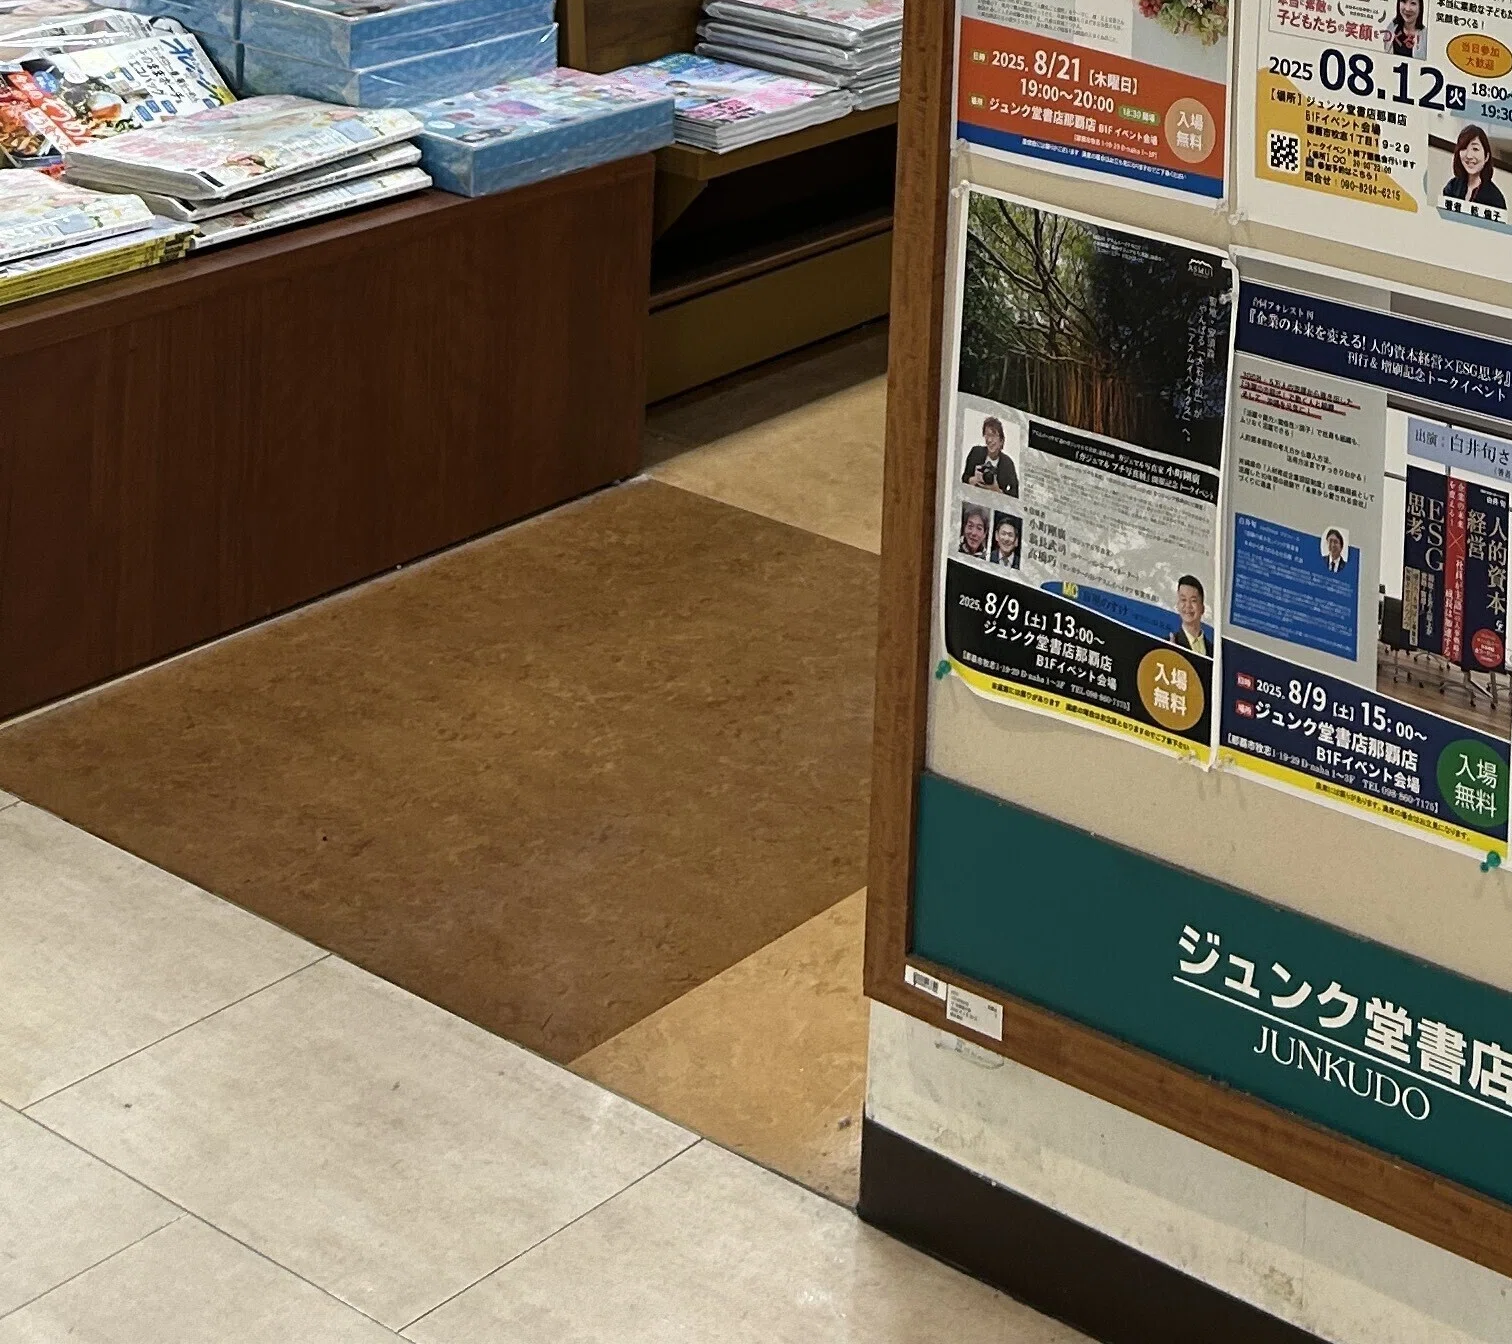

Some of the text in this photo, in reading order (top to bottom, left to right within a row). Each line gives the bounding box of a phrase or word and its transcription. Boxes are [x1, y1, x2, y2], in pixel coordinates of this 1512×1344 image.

[992, 50, 1080, 82] 2025. 8/21
[1269, 48, 1446, 111] 2025 08.12
[989, 98, 1158, 146] ジュンク堂書店那覇店 イベント会場
[1177, 111, 1204, 129] 入場
[1305, 111, 1381, 135] B1Fイベント会場
[1306, 96, 1407, 126] ジュンク堂書店那覇店
[1176, 132, 1203, 151] 無料
[1406, 490, 1425, 542] 思考
[1466, 508, 1487, 559] 経営
[1425, 498, 1444, 571] ESG
[1486, 515, 1508, 614] 人的資本
[959, 592, 1020, 621] 2025. 8/9
[984, 620, 1113, 672] ジュンク堂書店那覇店
[1036, 656, 1117, 691] B1Fイベント会場
[1155, 662, 1187, 691] 入場
[1155, 691, 1186, 716] 無料
[1257, 679, 1326, 712] 2025. 8/9
[1256, 701, 1418, 772] ジュンク堂書店那覇店
[1316, 746, 1420, 794] B1Fイベント会場
[1458, 753, 1498, 789] 入場
[1455, 783, 1496, 818] 無料
[1253, 1024, 1432, 1122] JUNKUDO
